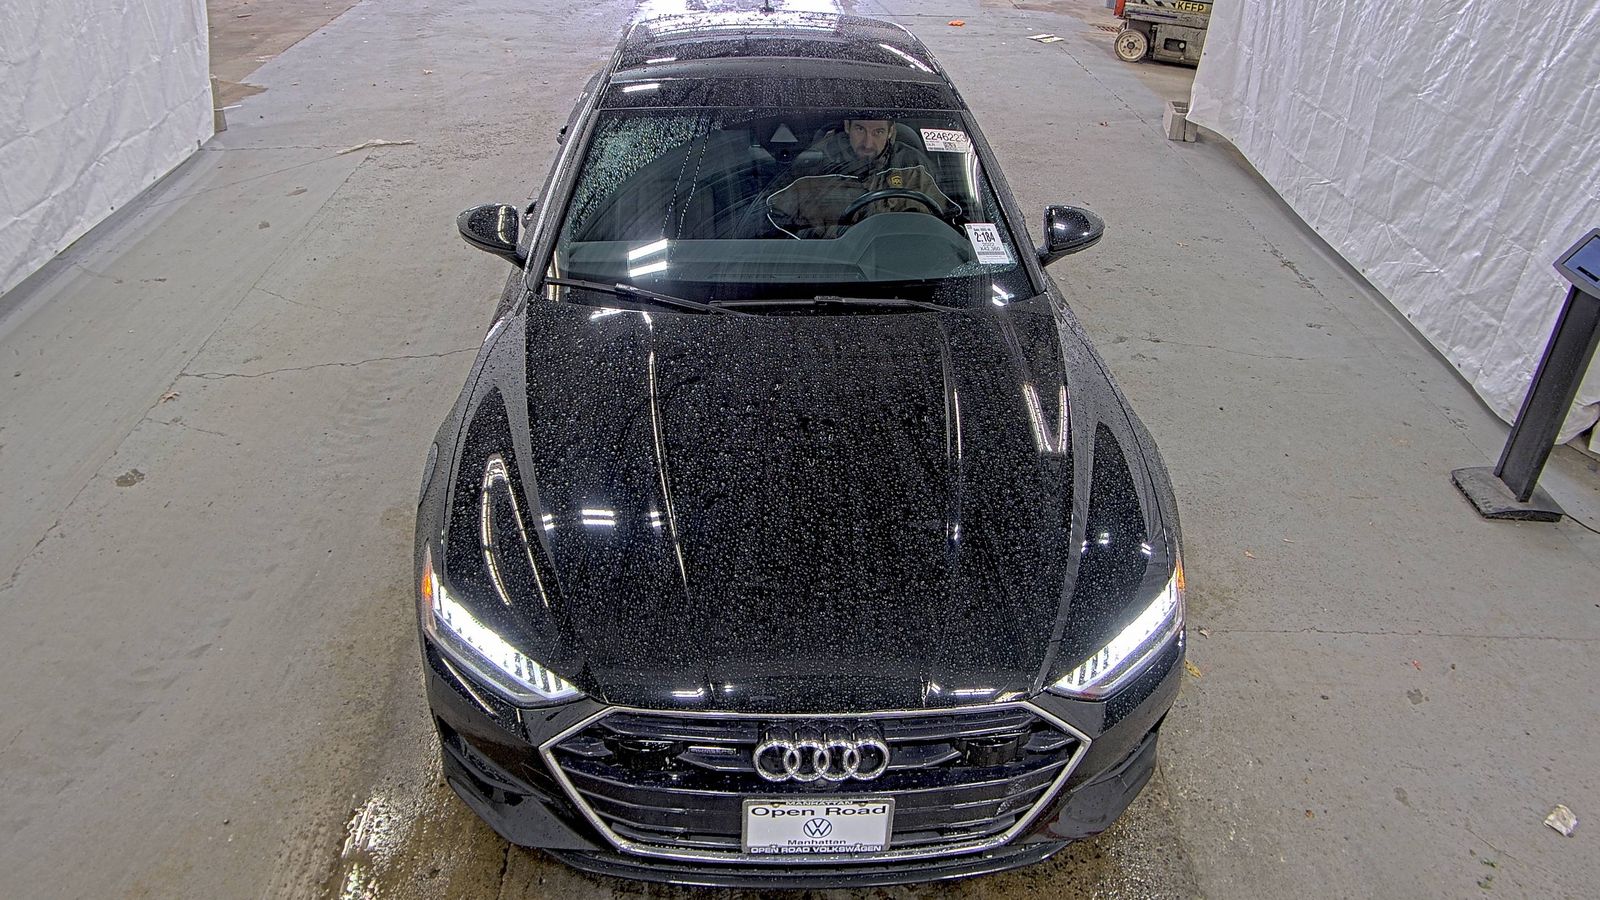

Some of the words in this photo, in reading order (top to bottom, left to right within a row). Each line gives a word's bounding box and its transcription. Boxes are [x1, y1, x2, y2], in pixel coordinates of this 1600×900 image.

[751, 807, 815, 818] Open
[825, 805, 887, 817] Road
[781, 846, 810, 854] ROAD
[813, 845, 882, 853] VOLKSWAGEN
